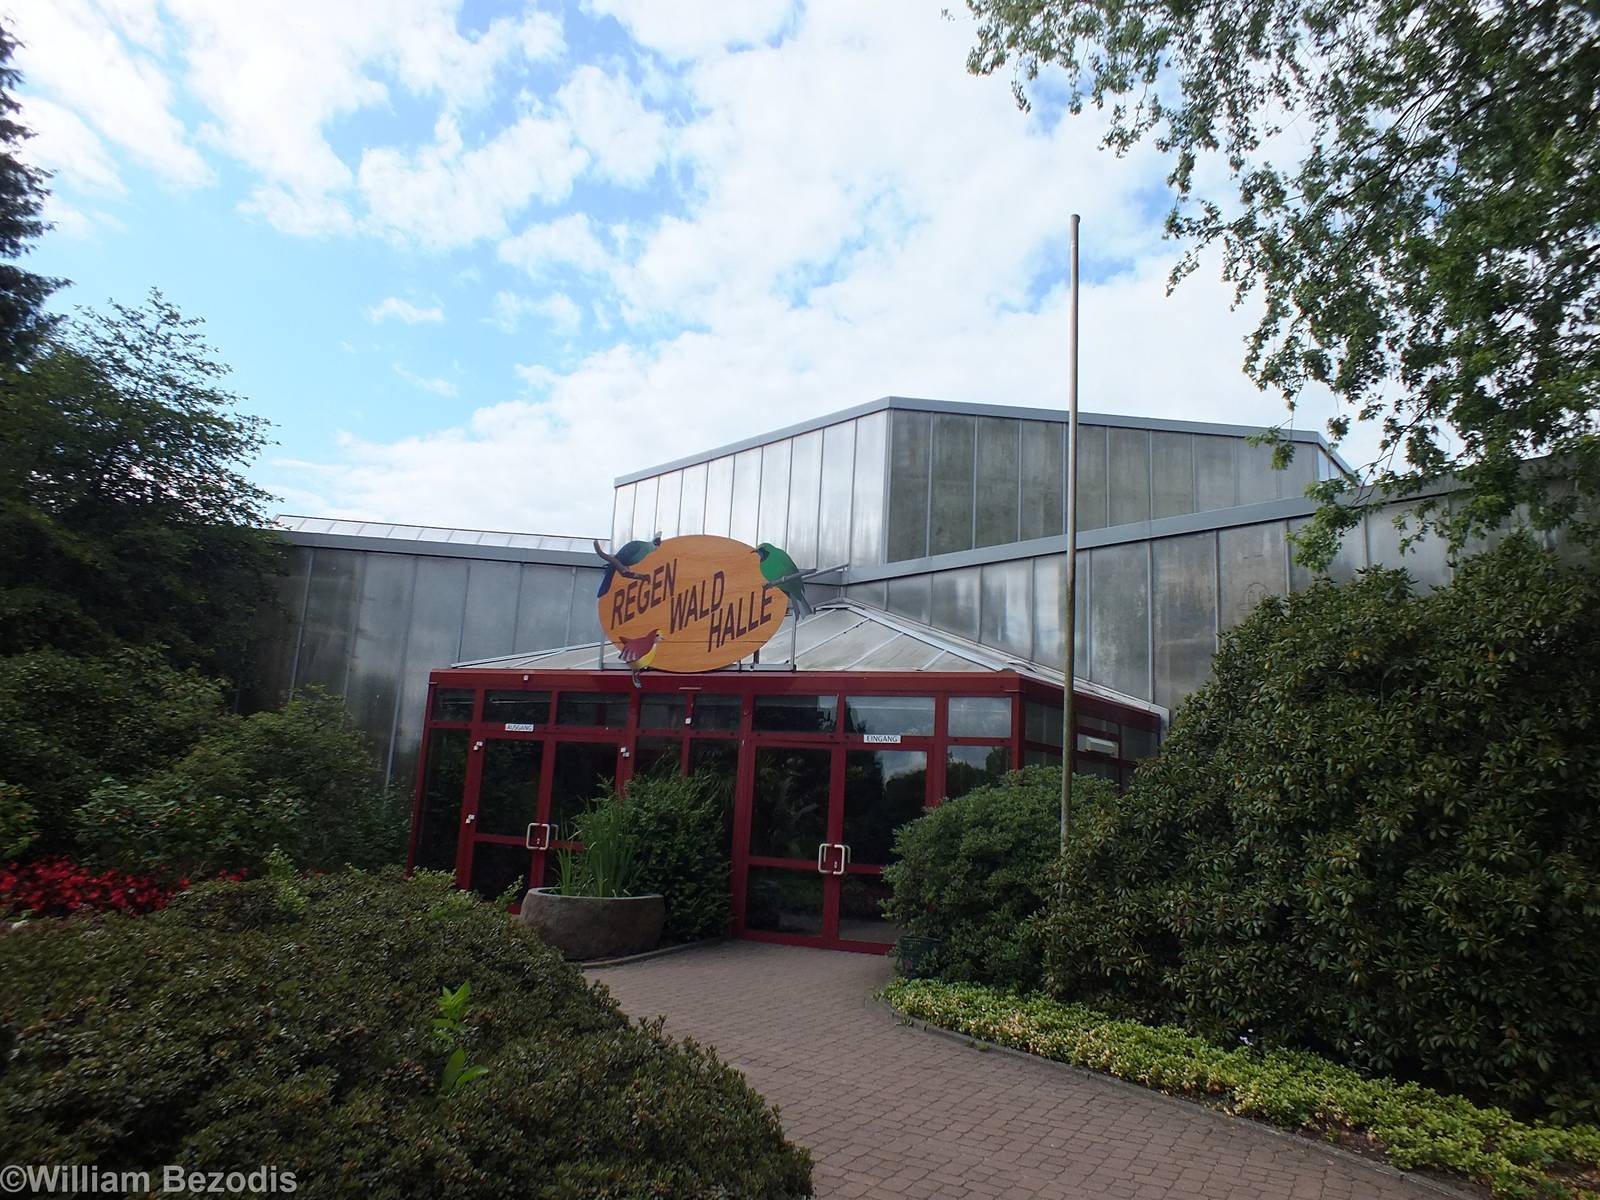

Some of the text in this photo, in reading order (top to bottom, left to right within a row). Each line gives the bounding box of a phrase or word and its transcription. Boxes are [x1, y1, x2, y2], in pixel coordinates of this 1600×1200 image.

[610, 558, 677, 630] REGEN
[670, 570, 725, 634] WALD
[707, 586, 773, 653] HALLE
